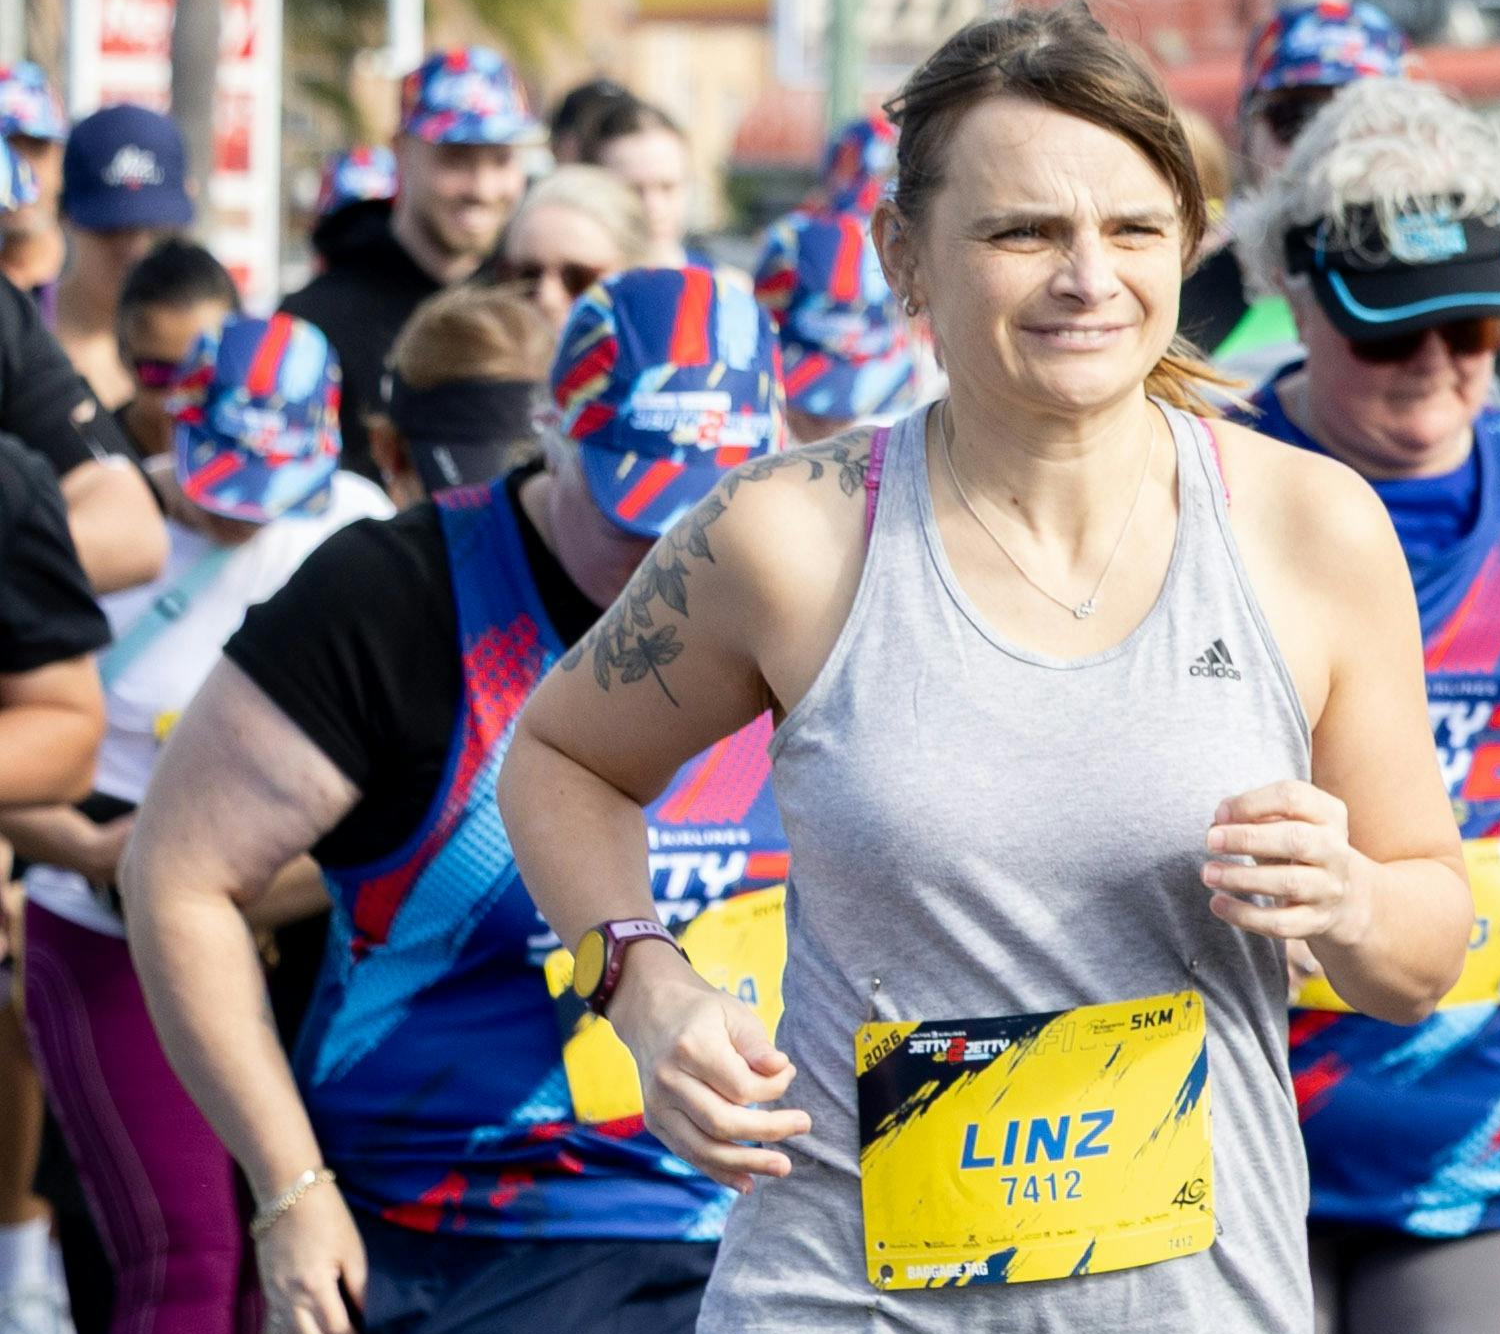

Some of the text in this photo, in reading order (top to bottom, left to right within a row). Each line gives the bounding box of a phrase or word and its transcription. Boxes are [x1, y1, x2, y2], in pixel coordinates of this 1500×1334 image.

[1130, 1008, 1173, 1030] 5KM
[863, 1029, 901, 1069] 2026
[960, 1109, 1115, 1169] LINZ
[1000, 1170, 1082, 1205] 7412
[906, 1262, 988, 1279] BAGGAGE TAG
